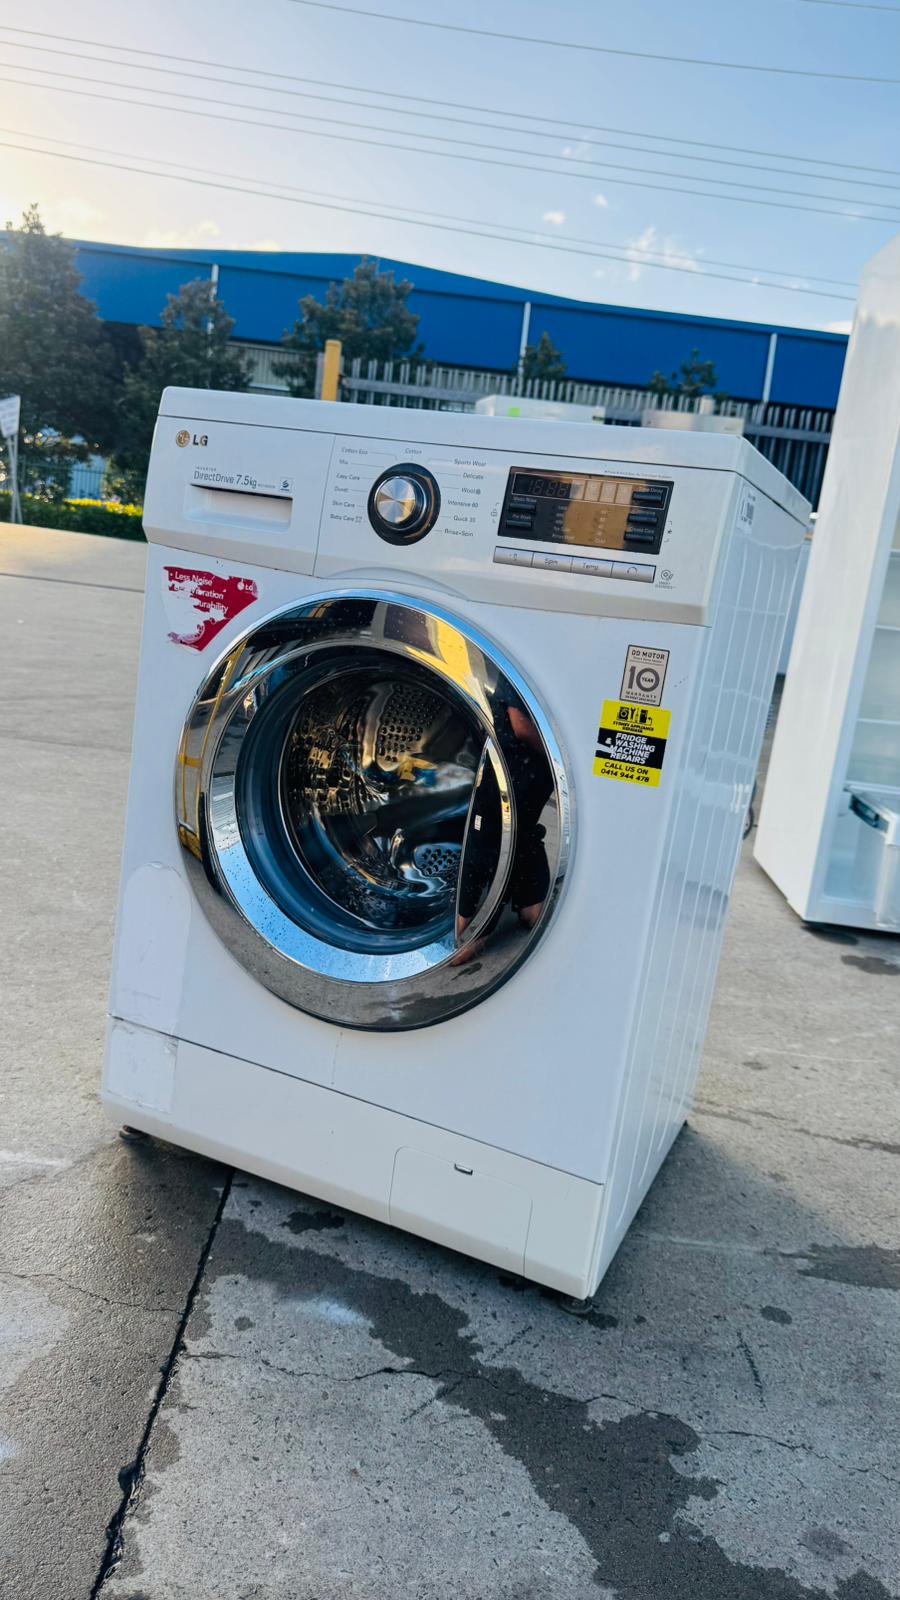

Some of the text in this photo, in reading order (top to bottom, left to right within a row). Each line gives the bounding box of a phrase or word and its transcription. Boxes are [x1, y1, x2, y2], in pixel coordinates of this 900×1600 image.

[192, 434, 208, 446] LG
[193, 470, 234, 484] DirectDrive
[236, 474, 257, 489] 7.5kg
[463, 472, 484, 480] Delicate
[175, 571, 213, 586] Less Noise
[200, 601, 228, 614] urability
[642, 651, 665, 660] MOTOR
[628, 666, 660, 692] 10
[616, 732, 647, 744] FRIDGE
[609, 745, 650, 758] MACHINE
[616, 739, 656, 752] WASHING
[610, 751, 646, 764] REPAIRS
[601, 768, 618, 776] 0414
[605, 762, 622, 770] CALL
